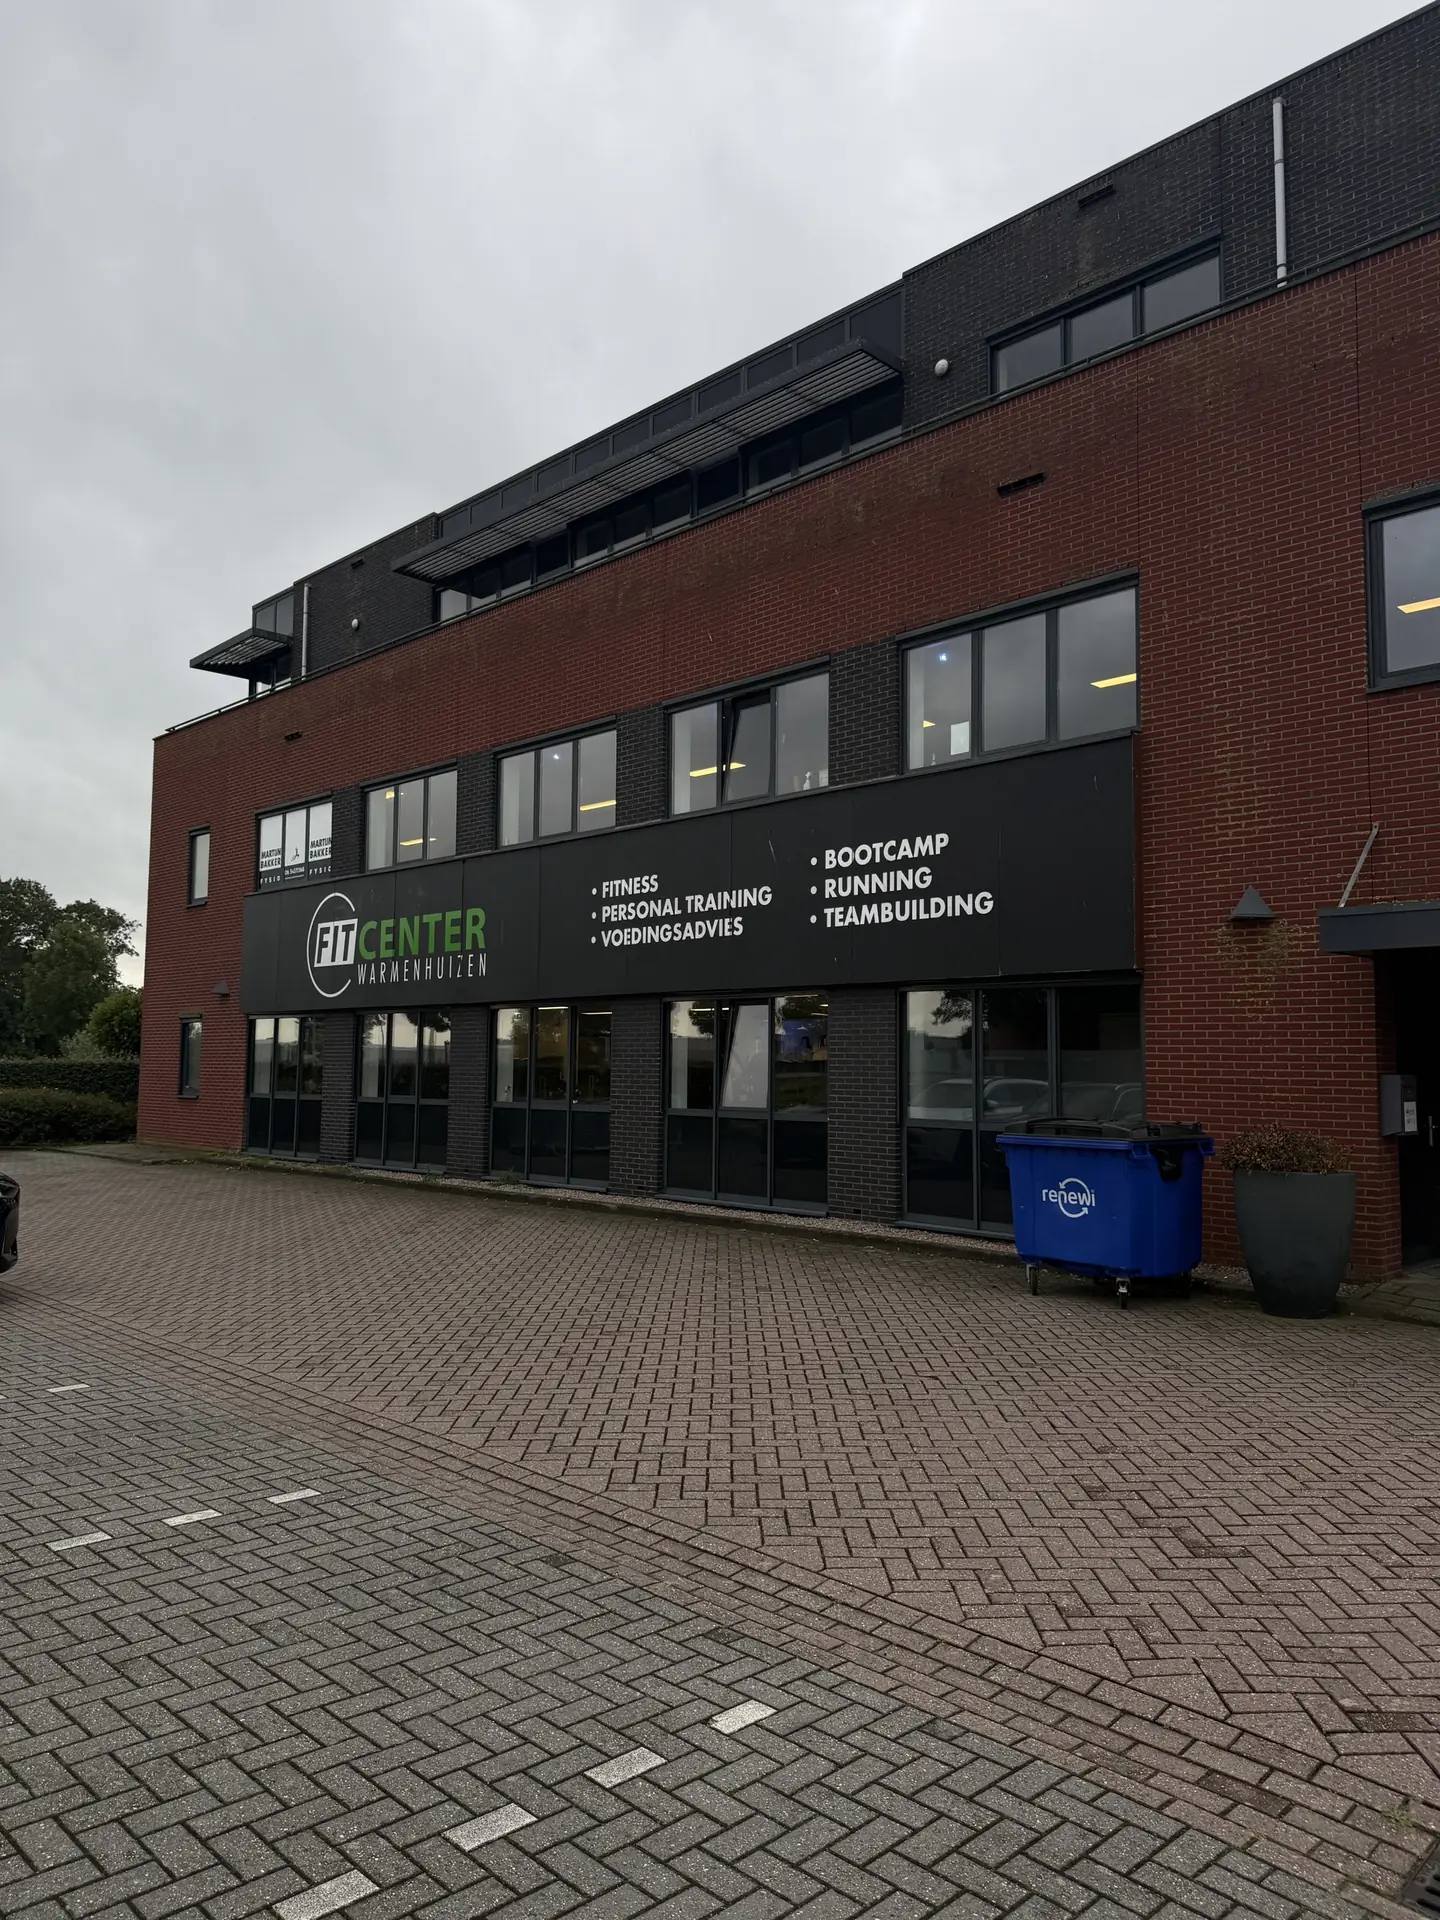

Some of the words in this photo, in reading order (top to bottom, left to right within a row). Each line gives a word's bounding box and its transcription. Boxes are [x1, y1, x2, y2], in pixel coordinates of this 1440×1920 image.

[260, 857, 281, 868] BAKKER
[825, 833, 950, 869] BOOTCAMP
[260, 875, 280, 884] FYSIO
[602, 874, 659, 898] FITNESS
[824, 866, 933, 898] RUNNING
[602, 897, 682, 923] PERSONAL
[685, 885, 773, 914] TRAINING
[824, 891, 994, 928] TEAMBUILDING
[316, 922, 357, 965] FIT
[358, 907, 487, 960] CENTER
[601, 916, 744, 947] VOEDINGSADVIES
[357, 952, 487, 985] WARMENHUIZEN
[1042, 1189, 1096, 1207] renewi
